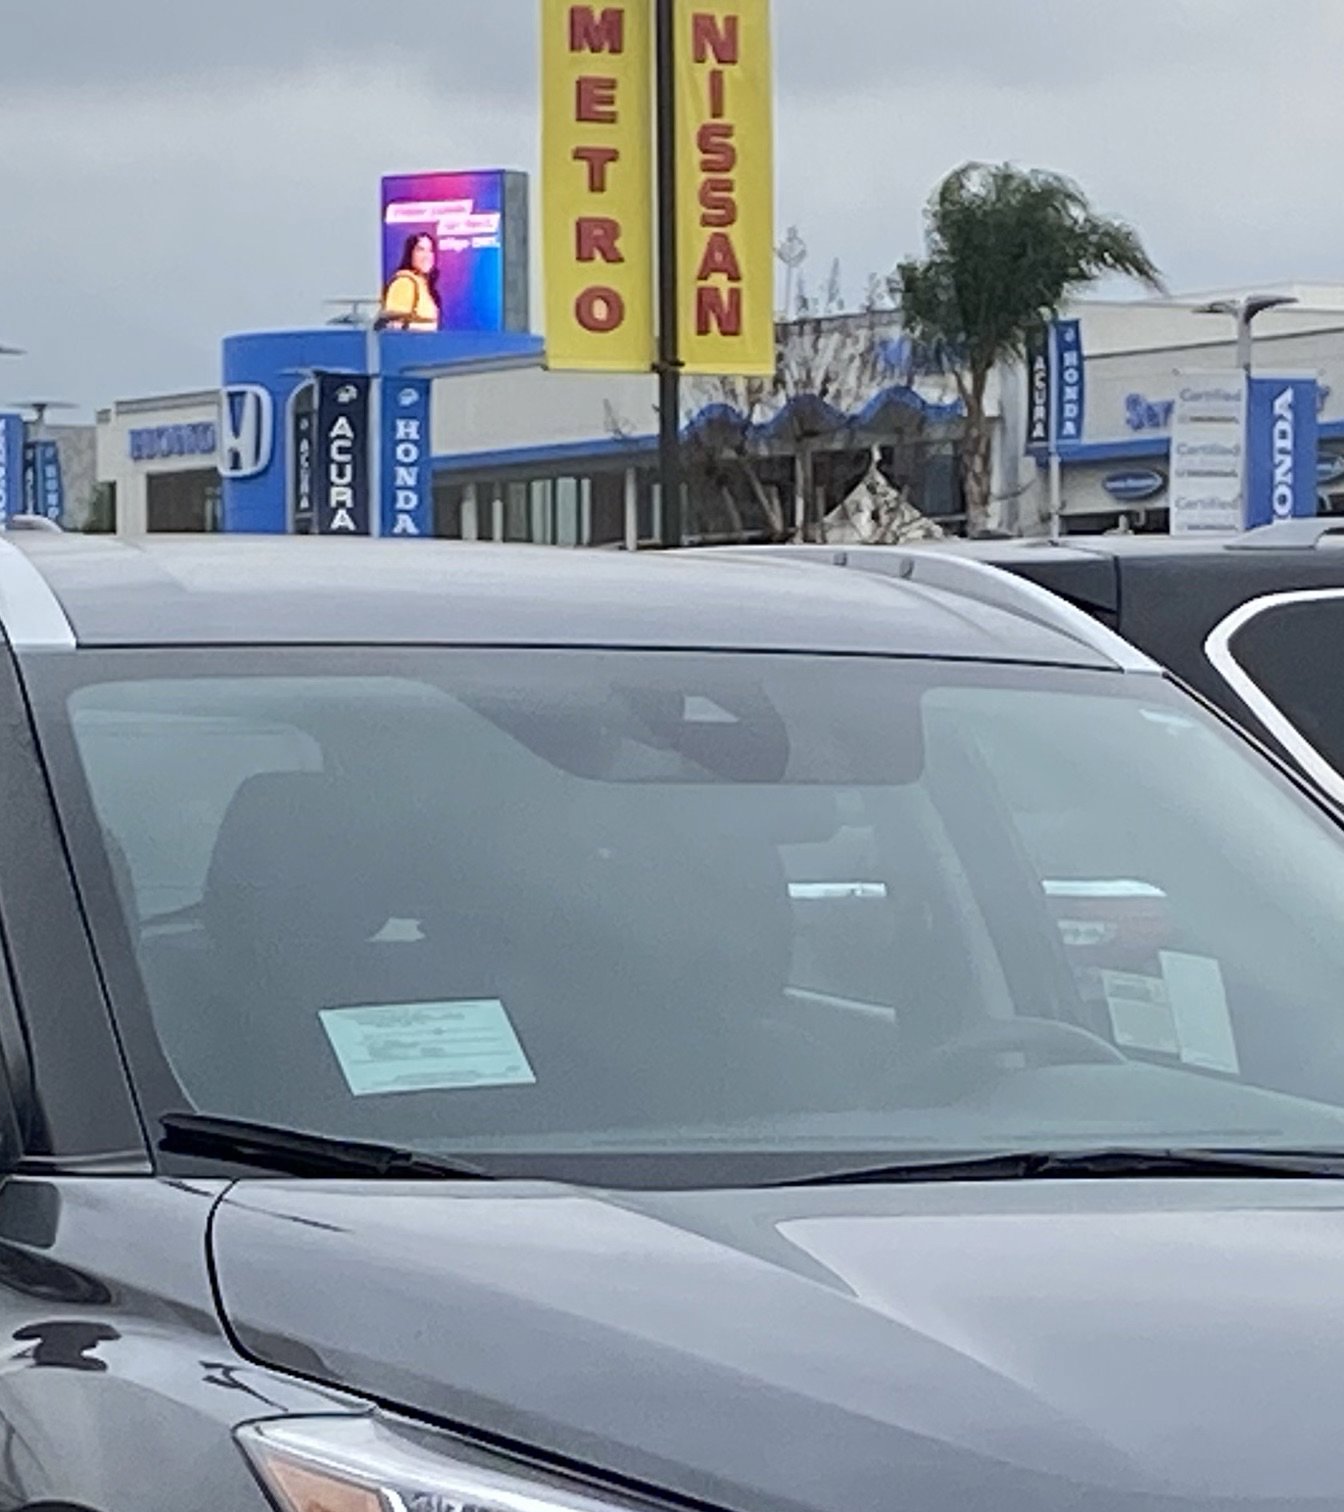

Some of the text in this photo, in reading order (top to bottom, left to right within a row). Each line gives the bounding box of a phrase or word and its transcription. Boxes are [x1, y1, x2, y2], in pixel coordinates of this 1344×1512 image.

[569, 5, 625, 333] METRO
[691, 12, 742, 337] NISSAN
[1032, 355, 1047, 438] ACURA
[1061, 351, 1080, 435] HONDA
[329, 415, 355, 531] ACURA
[393, 418, 420, 534] HONDA
[1273, 386, 1294, 517] ONDA
